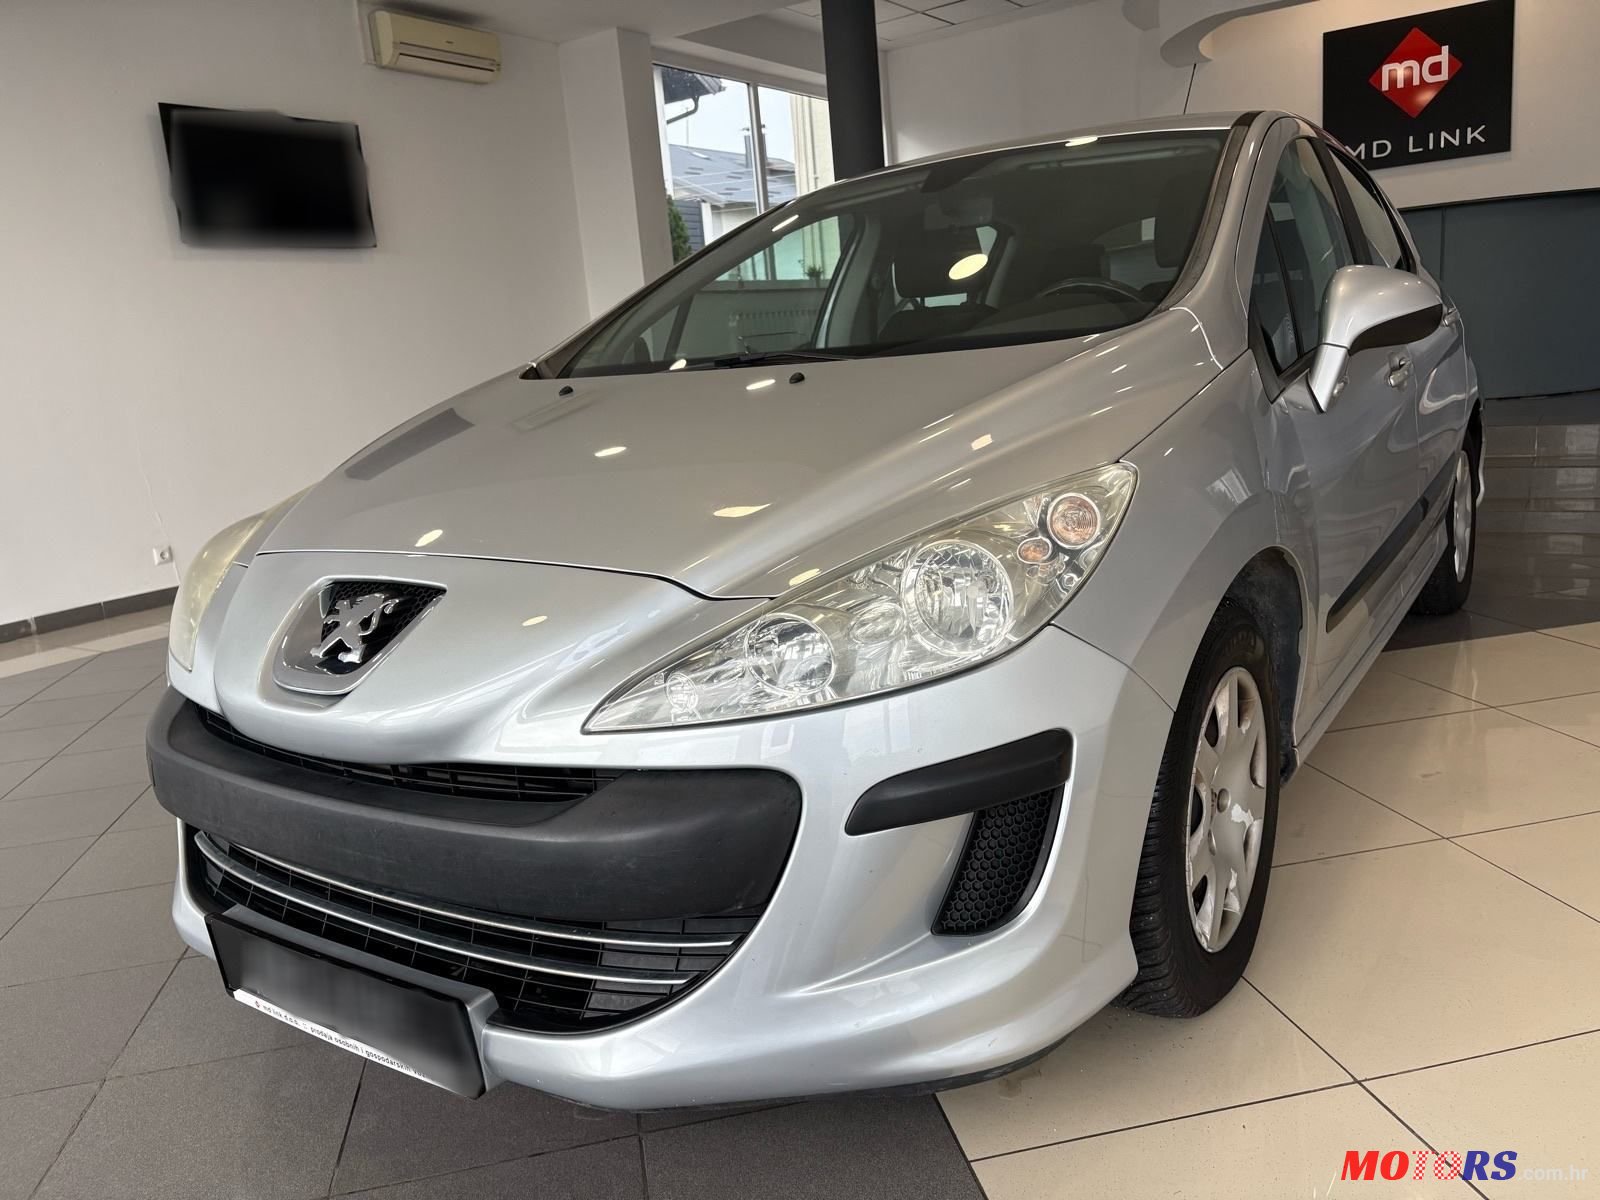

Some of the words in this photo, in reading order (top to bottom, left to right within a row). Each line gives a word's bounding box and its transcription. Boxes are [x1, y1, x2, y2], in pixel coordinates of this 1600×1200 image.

[1382, 45, 1449, 91] md
[1408, 124, 1486, 153] LINK
[310, 1026, 333, 1041] prodaja
